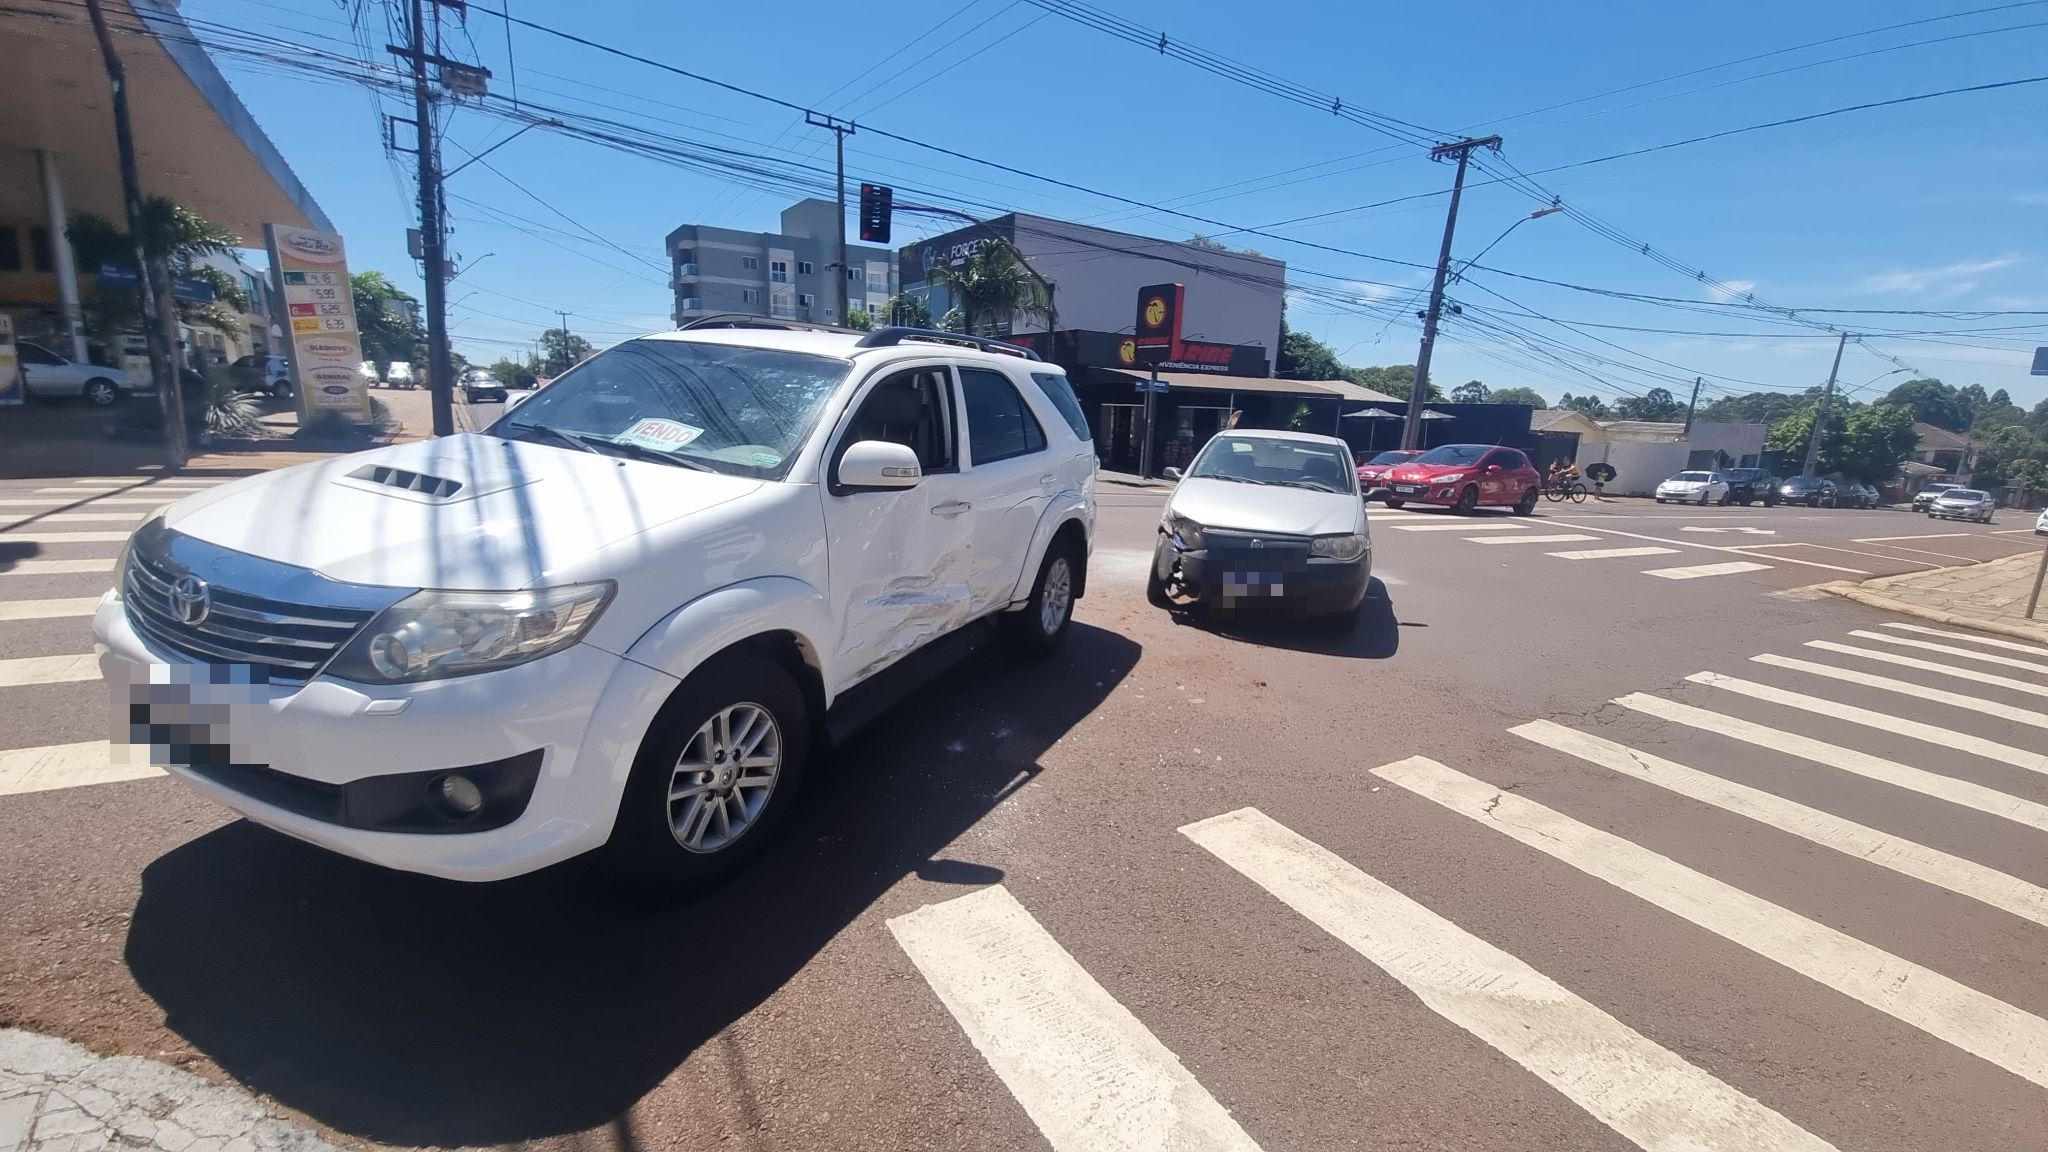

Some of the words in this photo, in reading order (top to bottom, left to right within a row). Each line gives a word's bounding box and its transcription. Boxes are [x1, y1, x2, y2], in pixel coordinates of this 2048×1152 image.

[950, 239, 979, 259] FORCE
[1200, 363, 1230, 373] EXPRESS
[633, 421, 695, 443] VENDO
